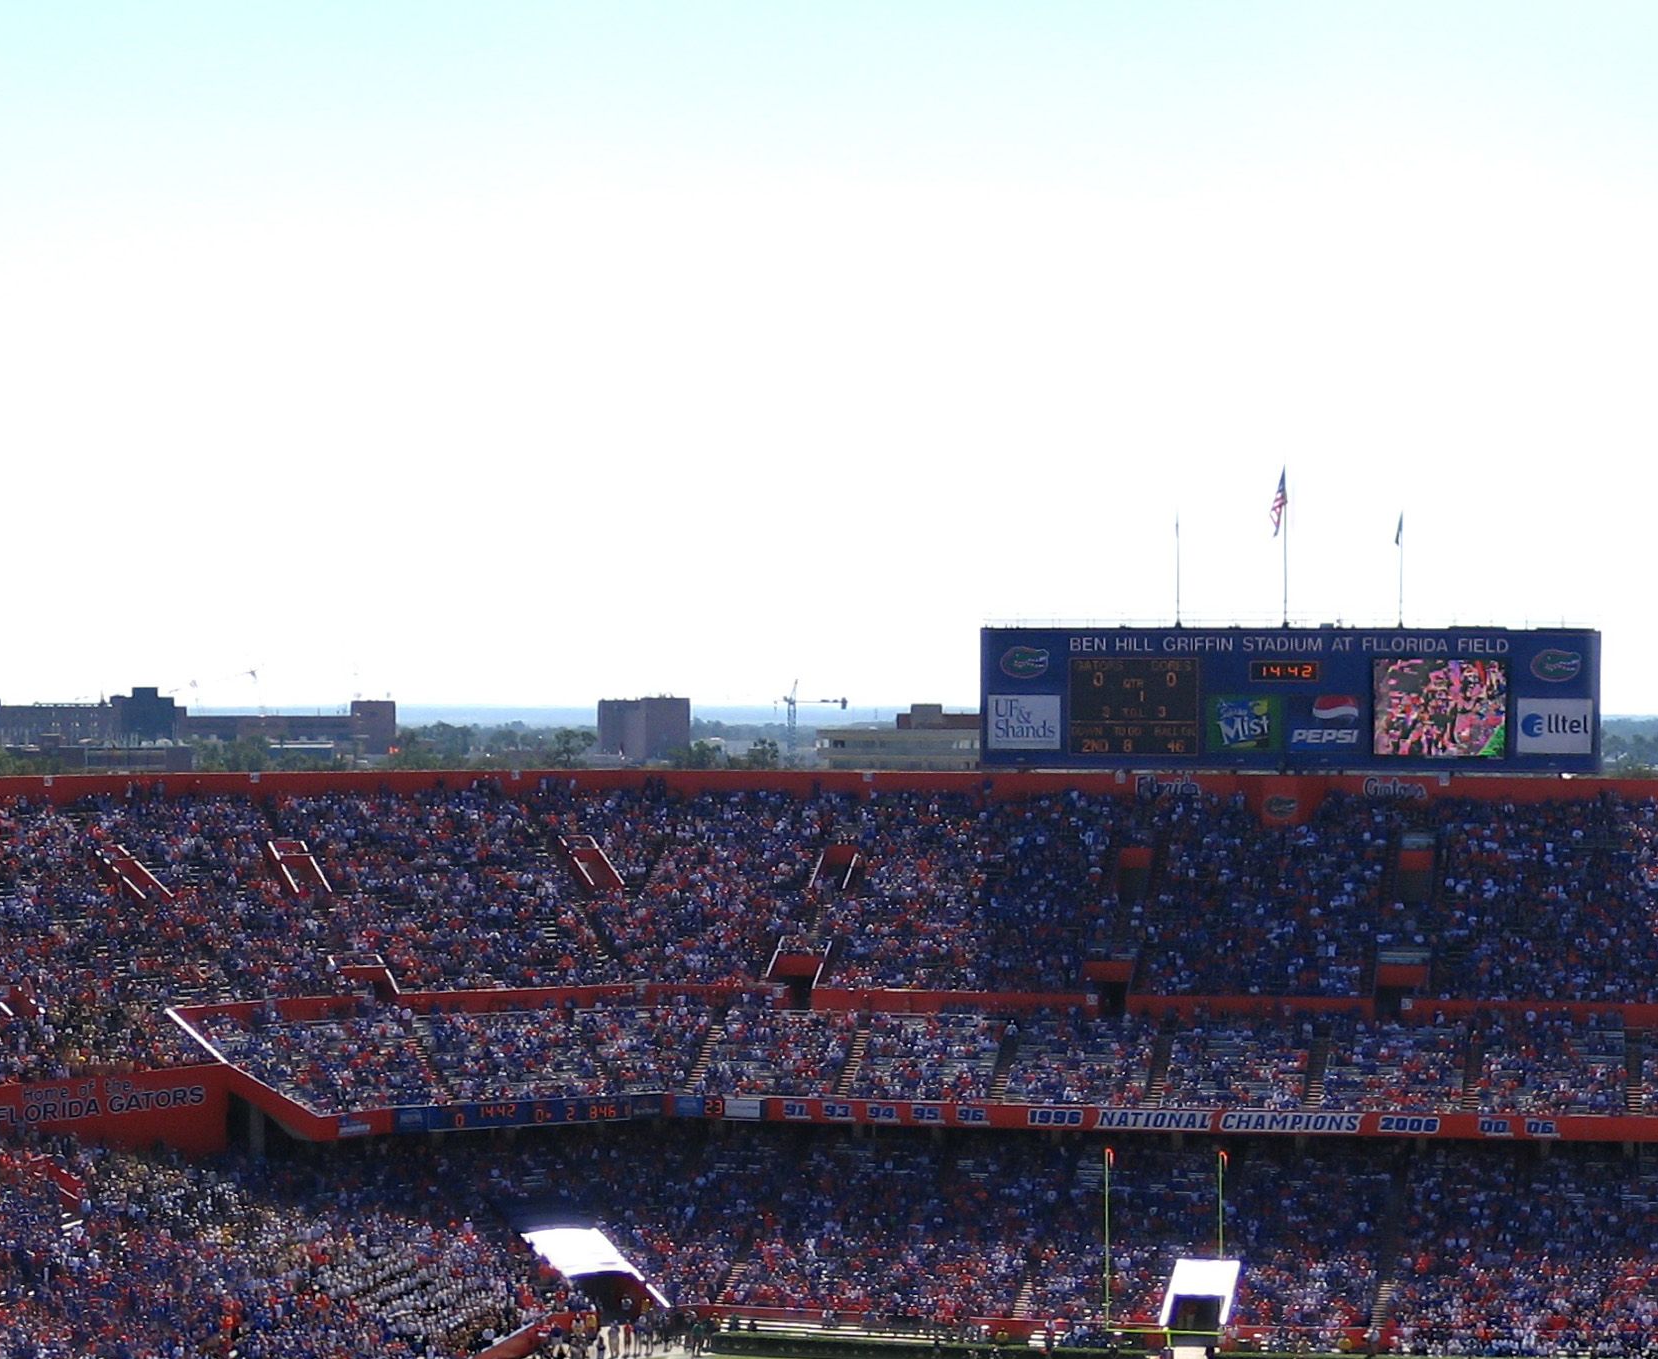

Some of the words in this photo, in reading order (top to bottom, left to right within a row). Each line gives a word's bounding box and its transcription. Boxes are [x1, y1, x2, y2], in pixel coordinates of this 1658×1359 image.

[1069, 637, 1107, 652] BEN
[1115, 637, 1154, 652] HILL
[1162, 637, 1234, 652] GRIFFIN
[1242, 637, 1323, 652] STADIUM
[1332, 638, 1353, 652] AT
[1457, 639, 1510, 654] FIELD
[1166, 671, 1177, 687] 0
[994, 698, 1018, 718] UF
[994, 720, 1057, 740] Shands
[1217, 715, 1270, 746] Mist
[1521, 713, 1590, 737] alltel
[1290, 729, 1360, 743] PEPSI
[22, 1086, 70, 1104] Home
[80, 1079, 96, 1096] of
[107, 1085, 207, 1114] GATORS
[703, 1099, 723, 1115] 23
[1029, 1109, 1083, 1126] 1996
[1099, 1111, 1212, 1129] NATIONAL
[1222, 1113, 1360, 1131] CHAMPIONS
[1380, 1116, 1440, 1133] 2006
